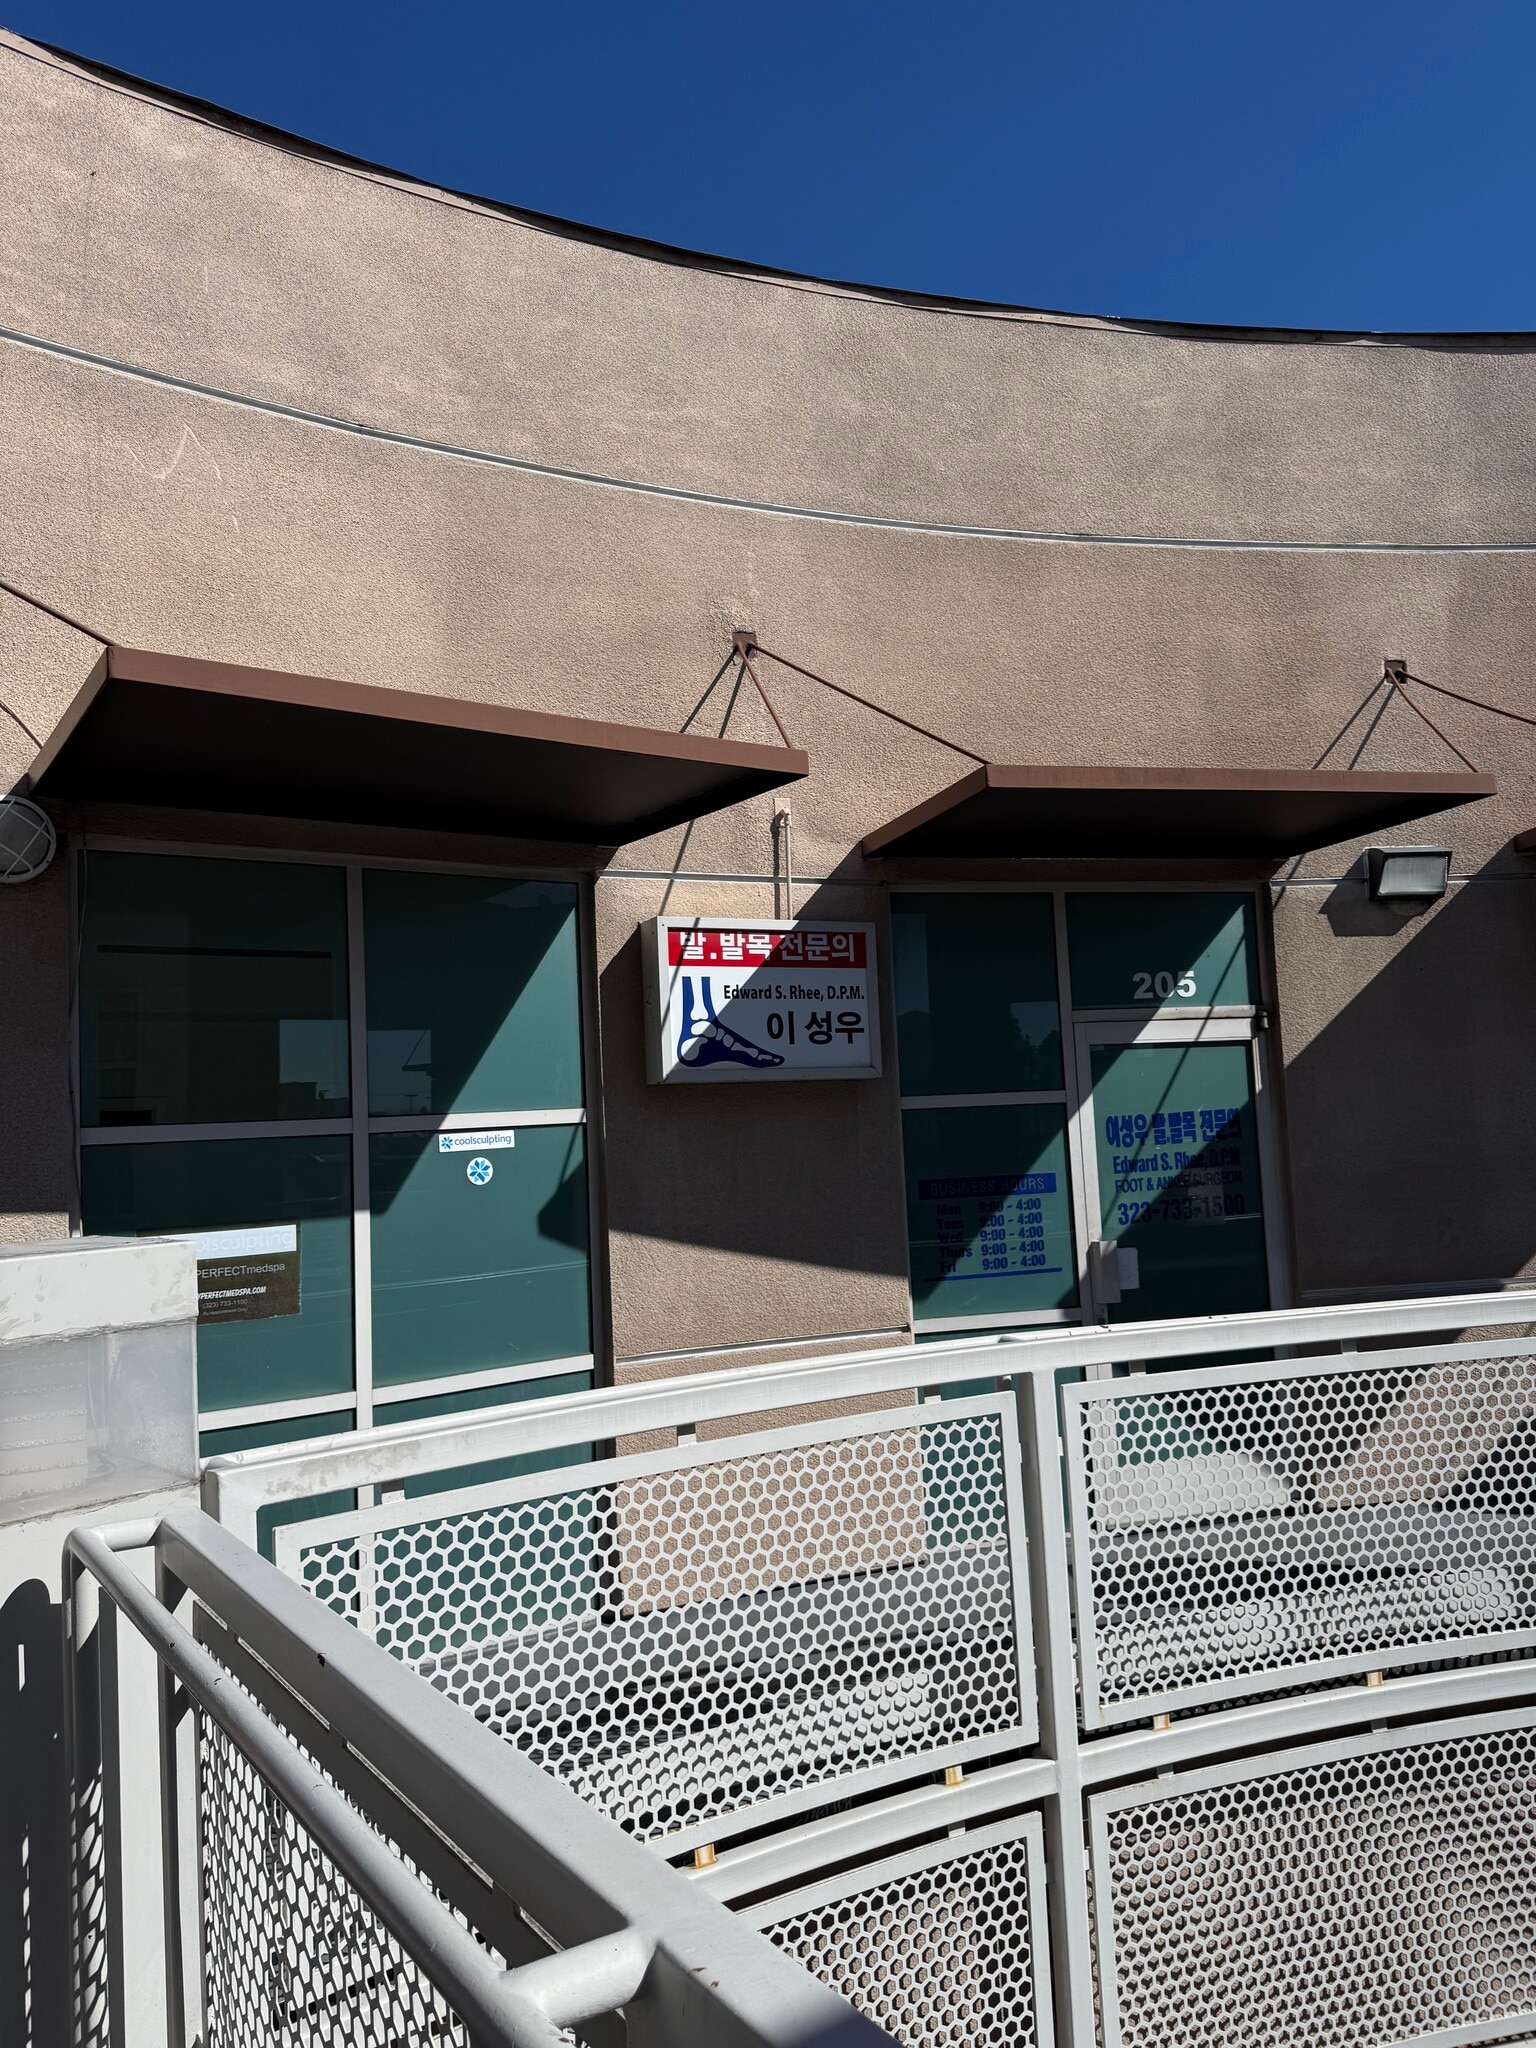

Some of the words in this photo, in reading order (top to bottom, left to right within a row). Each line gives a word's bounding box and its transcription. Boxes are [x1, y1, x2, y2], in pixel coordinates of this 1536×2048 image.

[779, 933, 855, 962] 전문의
[724, 985, 772, 1000] Edward
[775, 985, 787, 1000] S.
[790, 985, 824, 1001] Rhee,
[827, 986, 865, 1000] D.P.M.
[1132, 970, 1197, 999] 205
[454, 1134, 512, 1145] coolsculpting
[1106, 1113, 1148, 1148] 이성우
[1113, 1152, 1158, 1175] Edward
[1160, 1152, 1172, 1171] S.
[930, 1179, 996, 1196] BUSINESS
[1001, 1176, 1045, 1192] HOURS
[1115, 1177, 1144, 1193] FOOT
[1146, 1176, 1154, 1191] &
[1156, 1173, 1190, 1191] ANKLE
[1191, 1169, 1243, 1187] SURGEON
[936, 1203, 961, 1216] Mon
[979, 1200, 1004, 1213] 9:00
[1016, 1198, 1042, 1211] 4:00
[1117, 1193, 1246, 1226] 323-733-1500
[937, 1218, 965, 1230] Tues
[979, 1214, 1005, 1227] 9:00
[1017, 1211, 1043, 1224] 4:00
[938, 1232, 963, 1244] Wed
[980, 1229, 1006, 1241] 9:00
[1018, 1225, 1044, 1239] 4:00
[939, 1247, 973, 1259] Thurs
[981, 1242, 1007, 1256] 9:00
[1019, 1239, 1045, 1253] 4:00
[940, 1260, 956, 1273] Fri
[982, 1256, 1008, 1270] 9:00
[1020, 1253, 1046, 1267] 4:00
[202, 1300, 219, 1310] (323)
